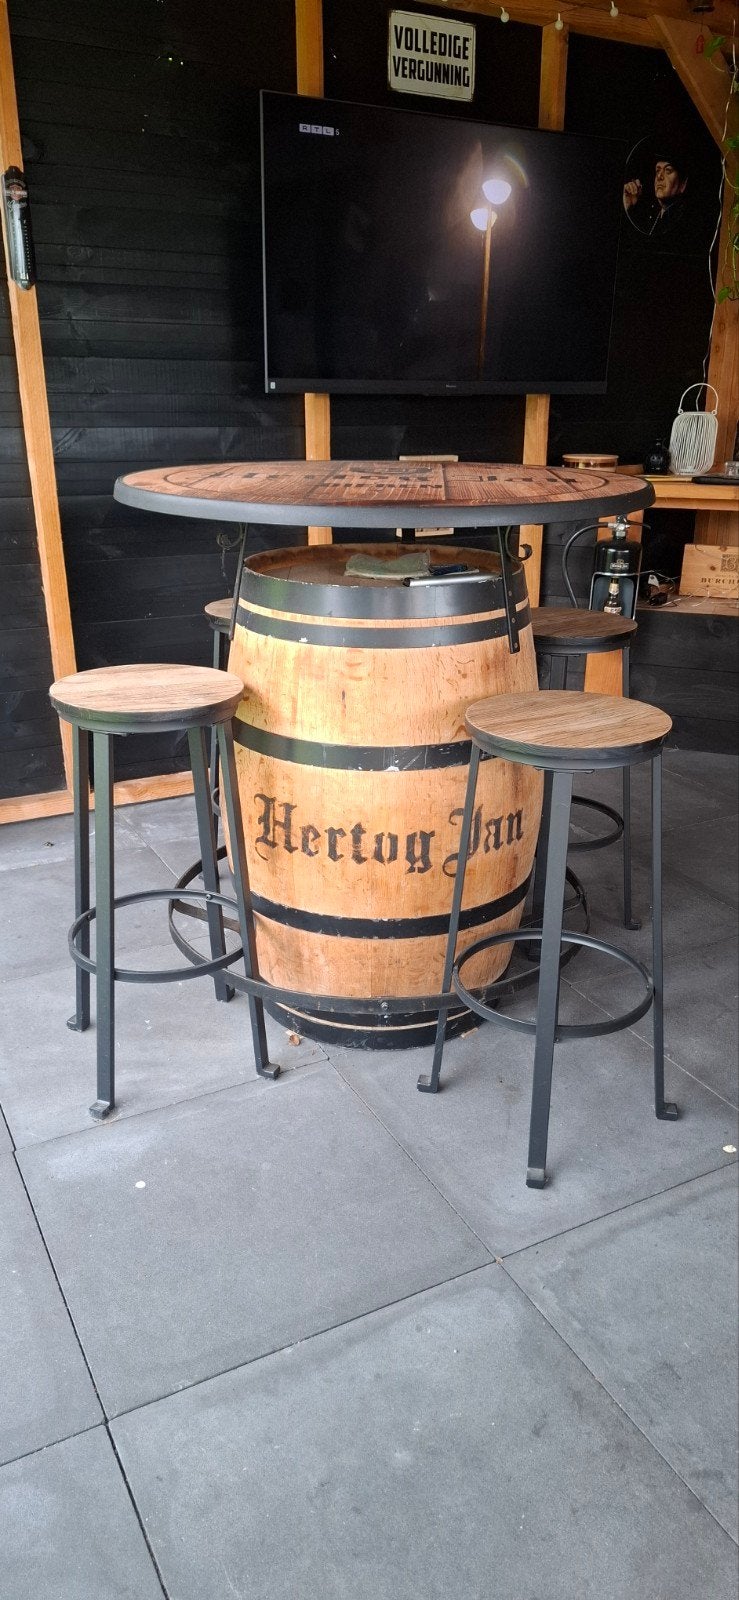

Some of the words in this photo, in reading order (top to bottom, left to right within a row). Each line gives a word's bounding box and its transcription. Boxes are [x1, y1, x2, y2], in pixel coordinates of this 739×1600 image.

[394, 25, 470, 60] VOLLEDIGE
[393, 55, 470, 88] VERGUNNING
[701, 577, 739, 585] BURCH
[254, 793, 436, 874] Hertog
[442, 804, 524, 877] Jan
